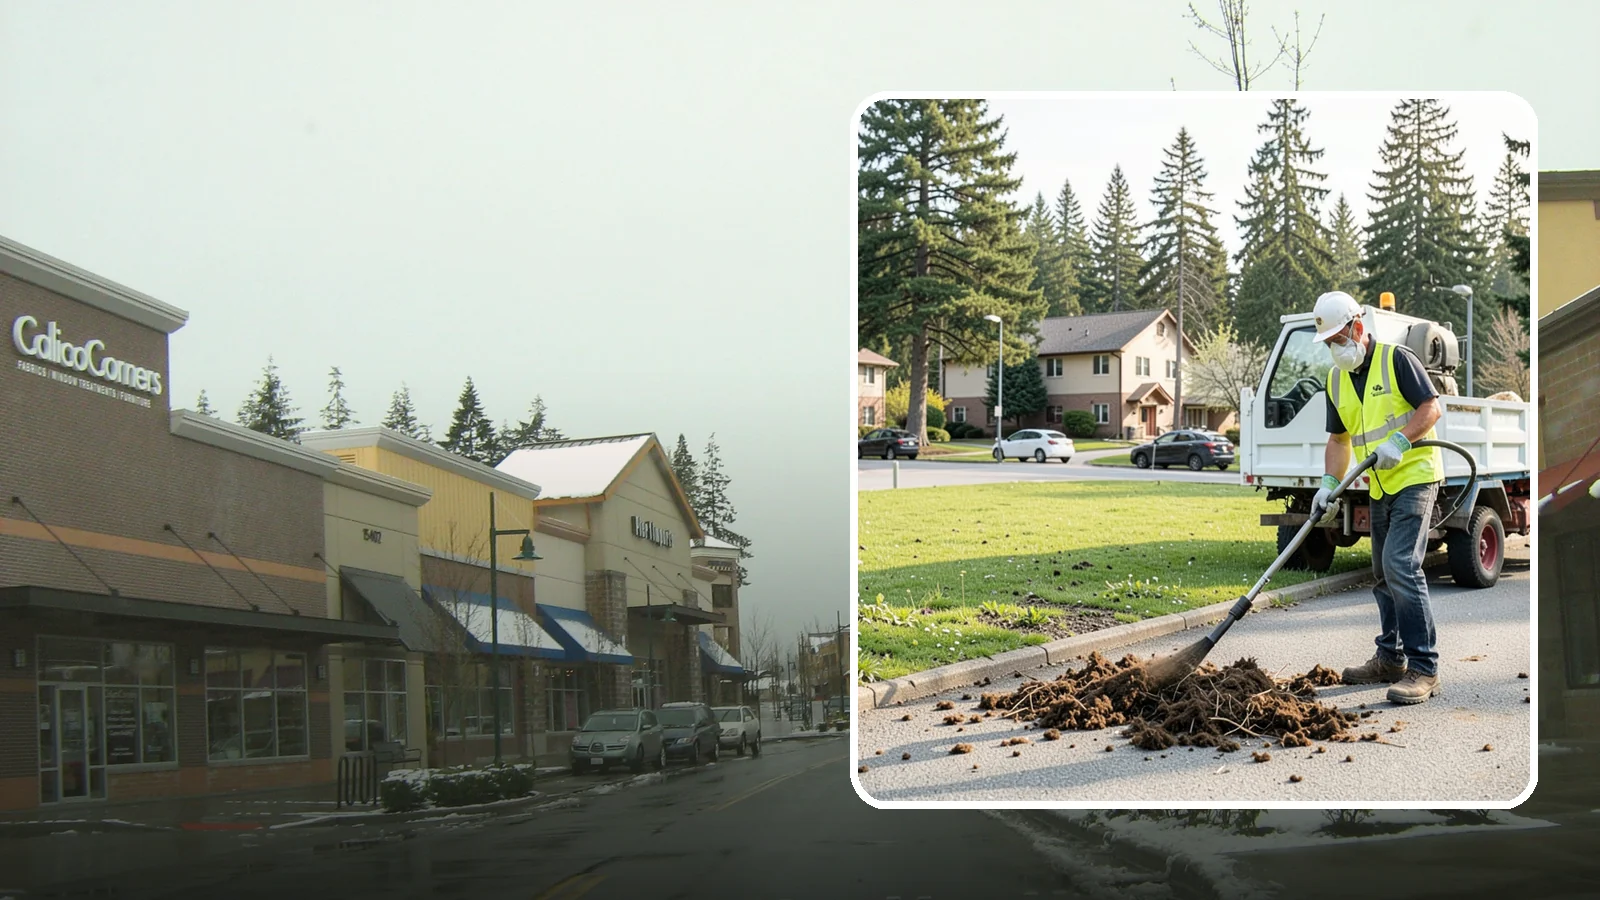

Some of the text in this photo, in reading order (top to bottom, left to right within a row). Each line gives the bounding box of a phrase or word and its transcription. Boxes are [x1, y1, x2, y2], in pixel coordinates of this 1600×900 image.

[17, 359, 47, 377] FABRICS
[51, 370, 78, 387] WINDOW
[79, 378, 116, 398] TREATMENTS
